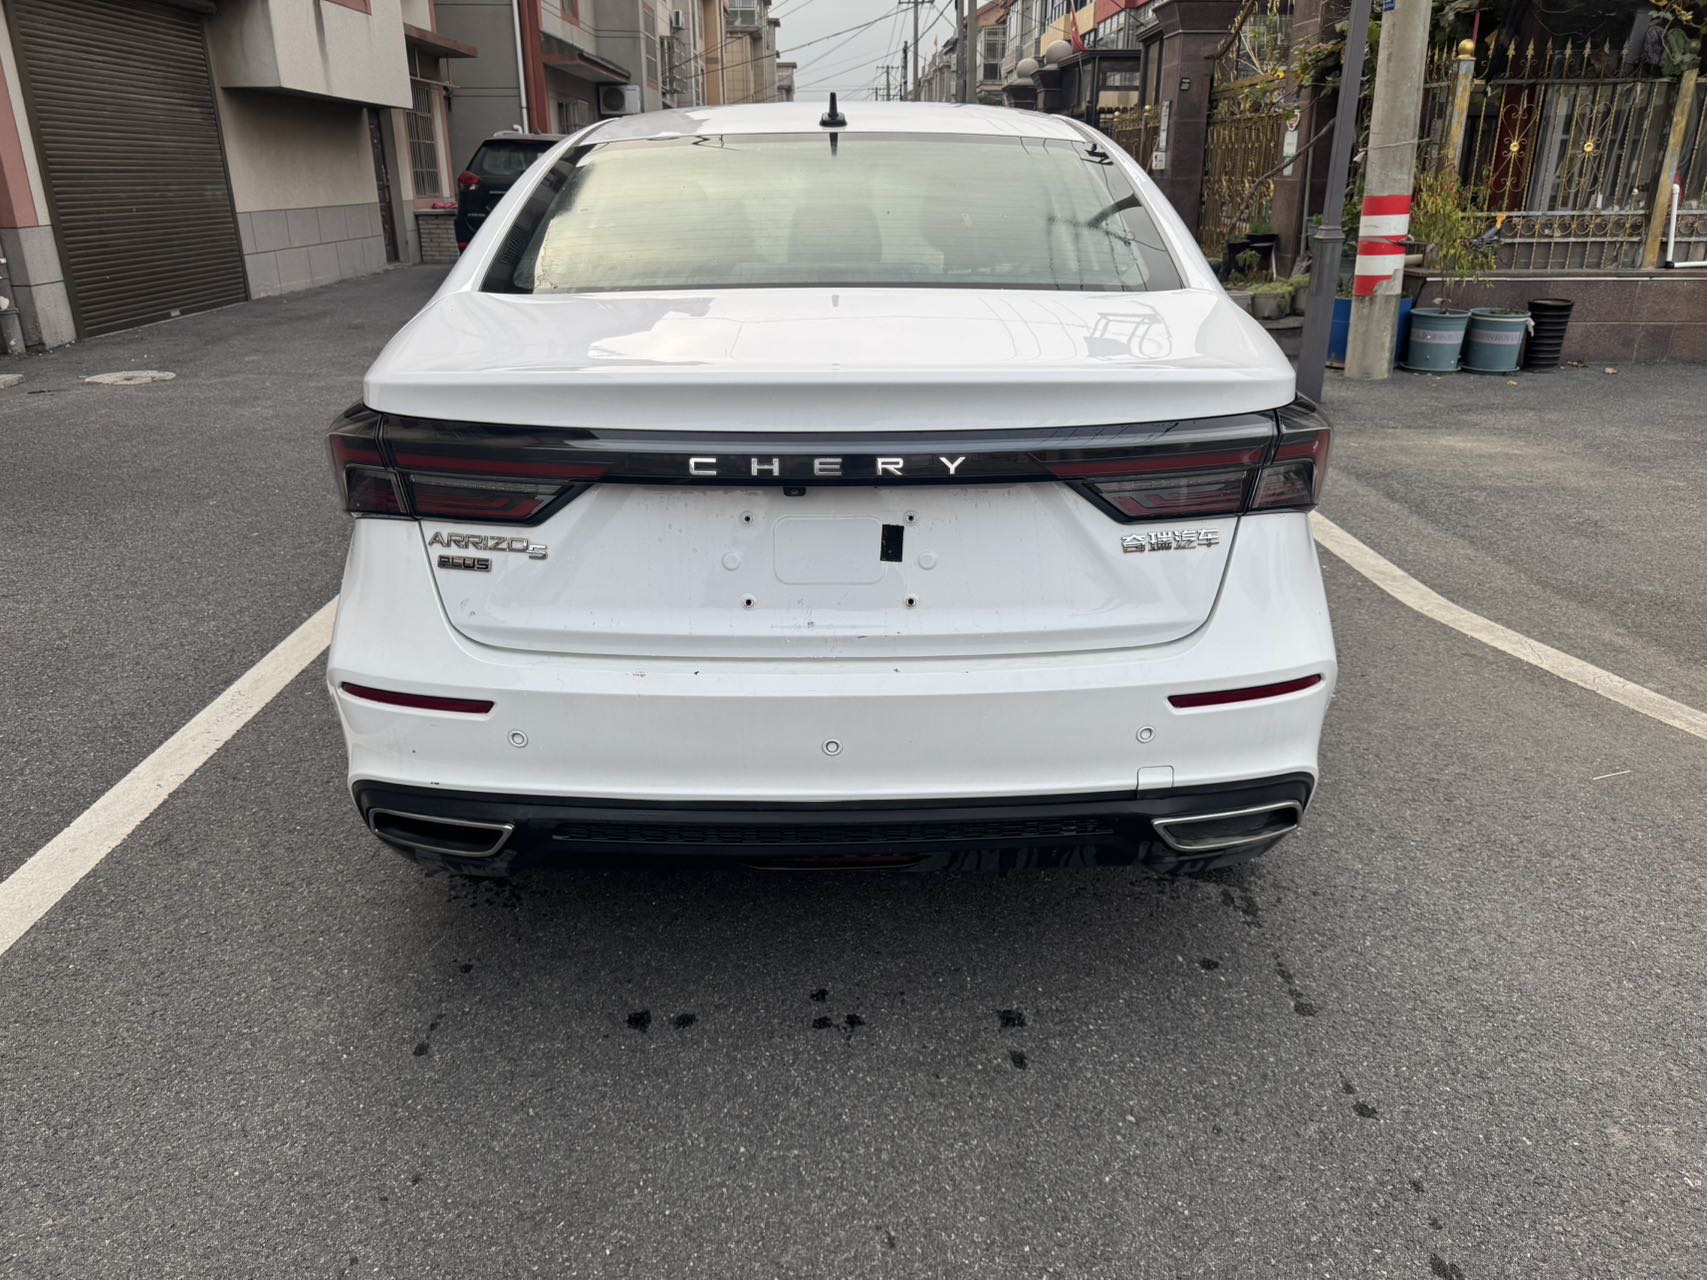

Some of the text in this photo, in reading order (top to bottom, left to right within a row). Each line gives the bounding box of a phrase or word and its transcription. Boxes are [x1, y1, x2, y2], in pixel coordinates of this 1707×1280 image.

[689, 456, 966, 476] CHERY
[1121, 528, 1220, 553] 奇瑞汽车
[438, 555, 491, 572] PLUS
